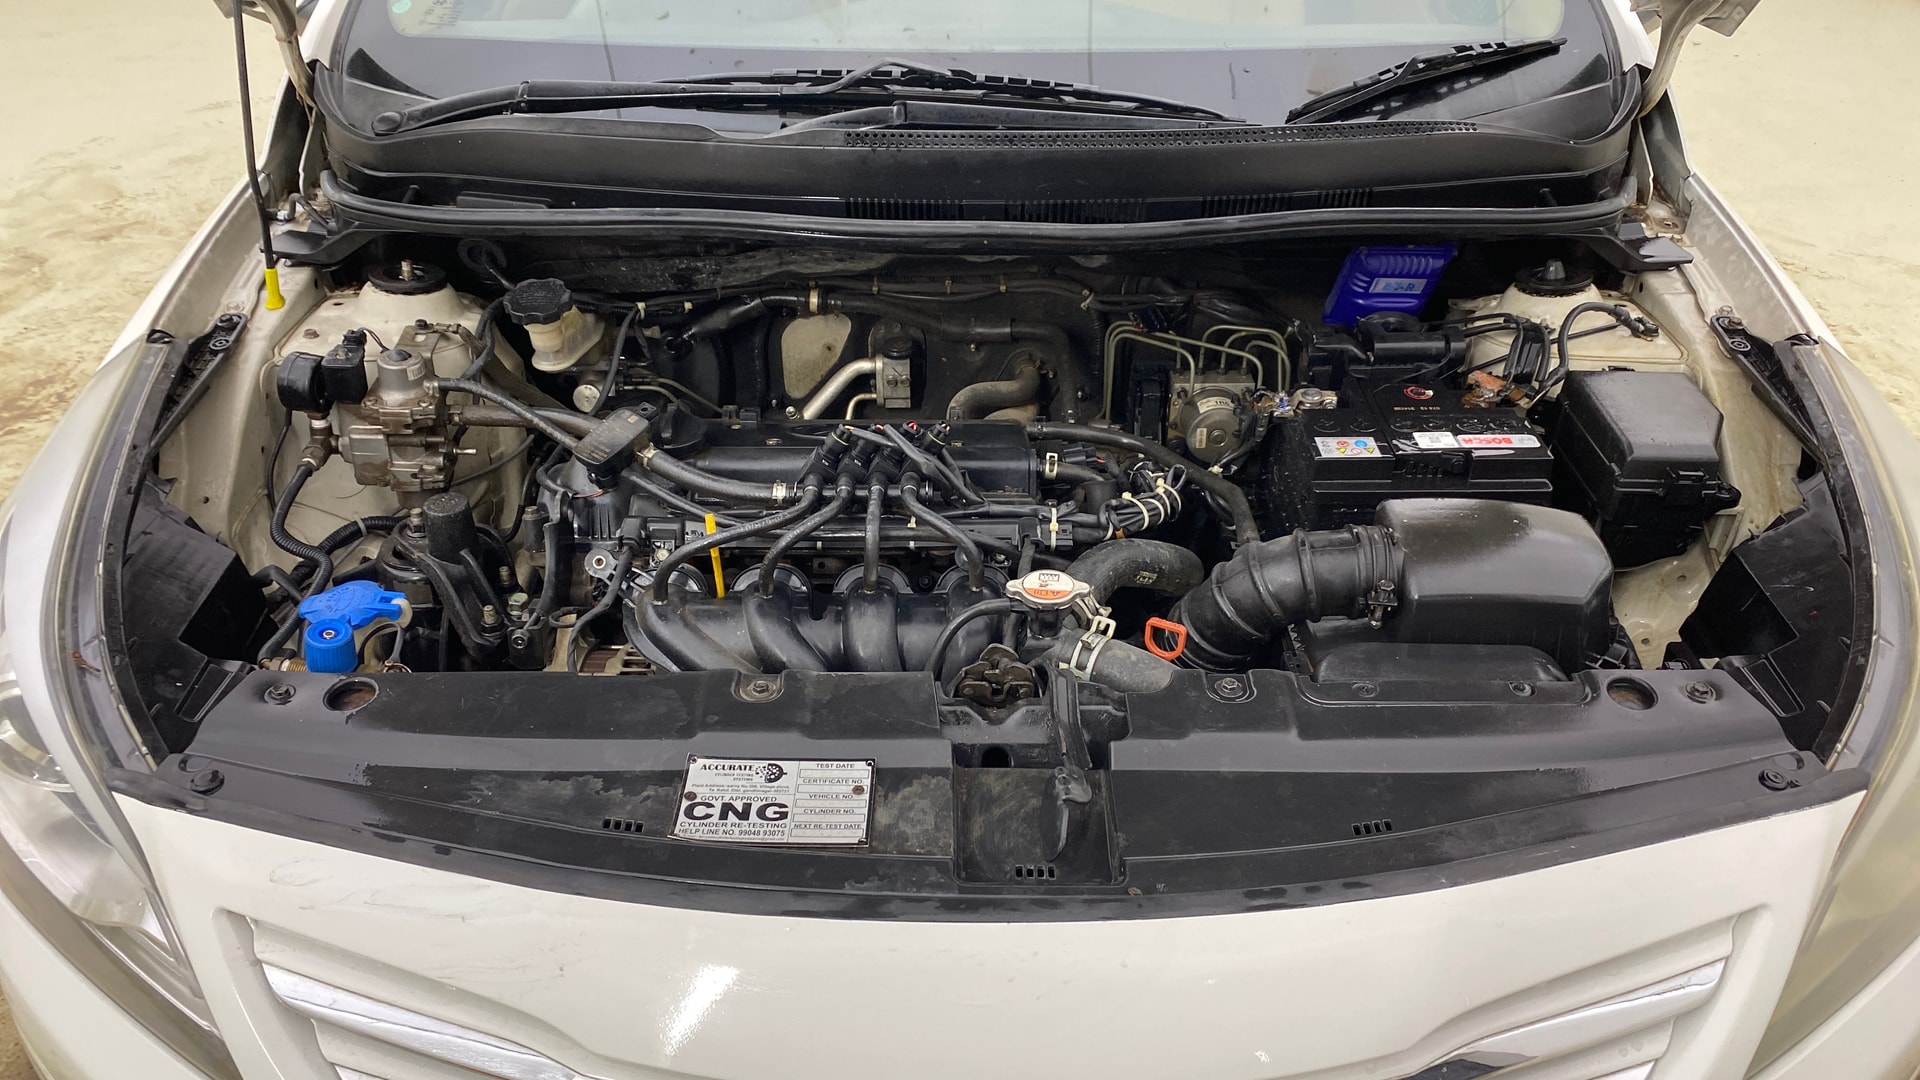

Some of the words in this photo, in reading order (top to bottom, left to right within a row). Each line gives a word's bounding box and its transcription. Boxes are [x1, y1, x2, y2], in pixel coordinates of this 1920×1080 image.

[1462, 437, 1513, 445] BOSCH
[700, 764, 755, 772] ACCURATE
[683, 801, 789, 822] CNG
[738, 829, 761, 837] 99048
